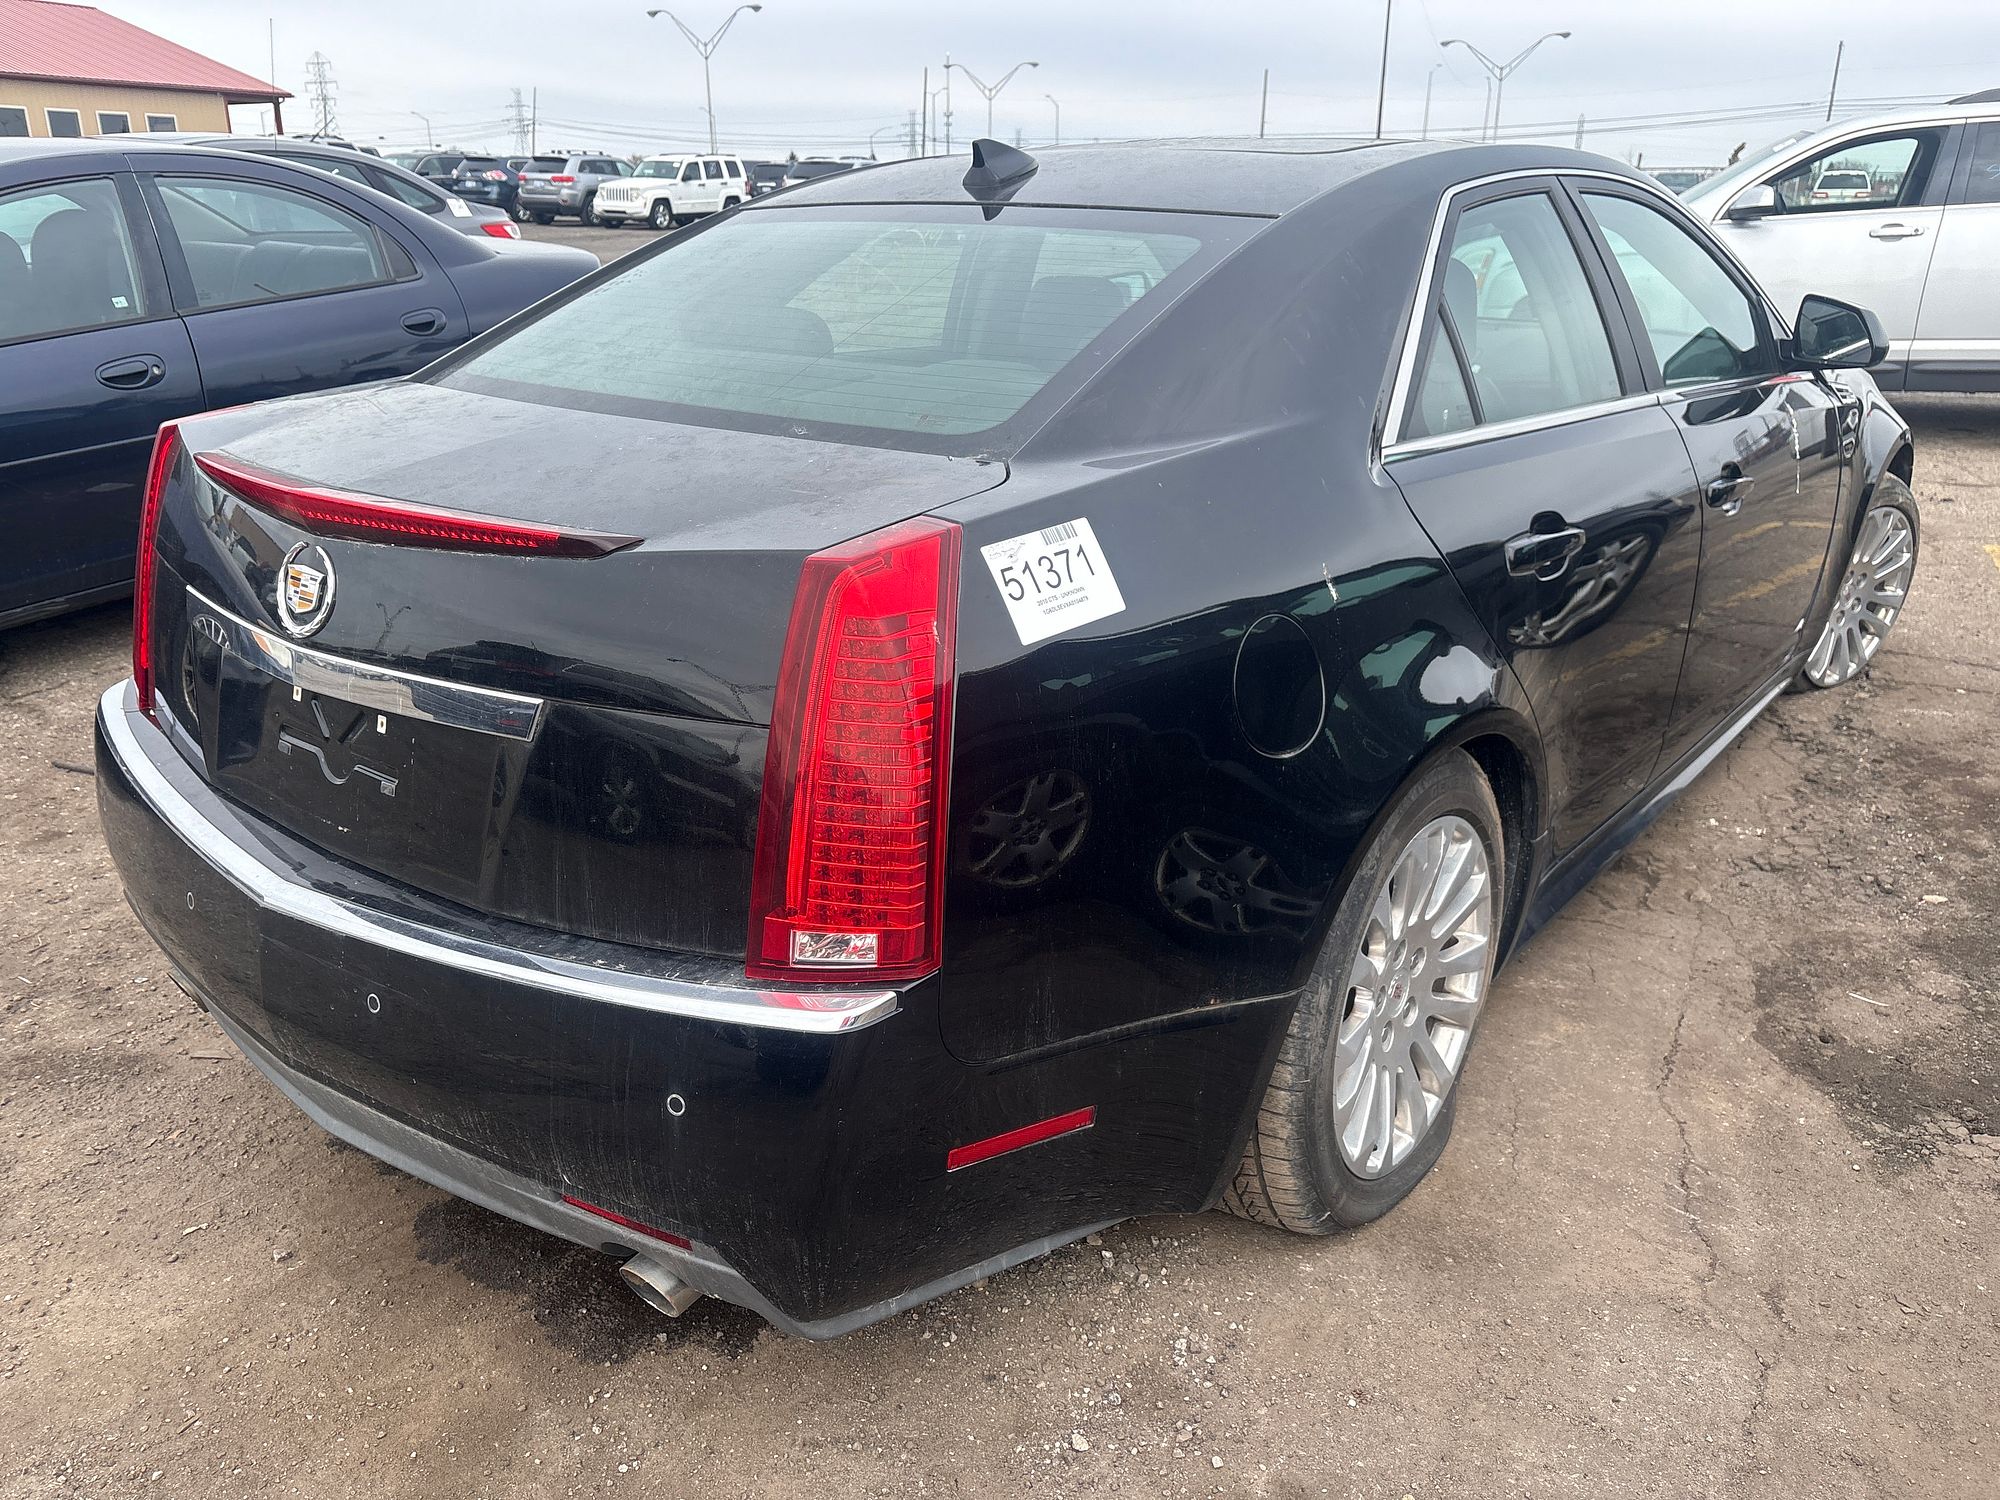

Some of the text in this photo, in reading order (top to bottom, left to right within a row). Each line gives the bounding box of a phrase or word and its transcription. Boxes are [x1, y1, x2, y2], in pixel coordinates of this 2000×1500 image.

[1000, 544, 1095, 602] 51371
[1048, 594, 1059, 603] CTS
[1060, 587, 1085, 599] UNKNOWN
